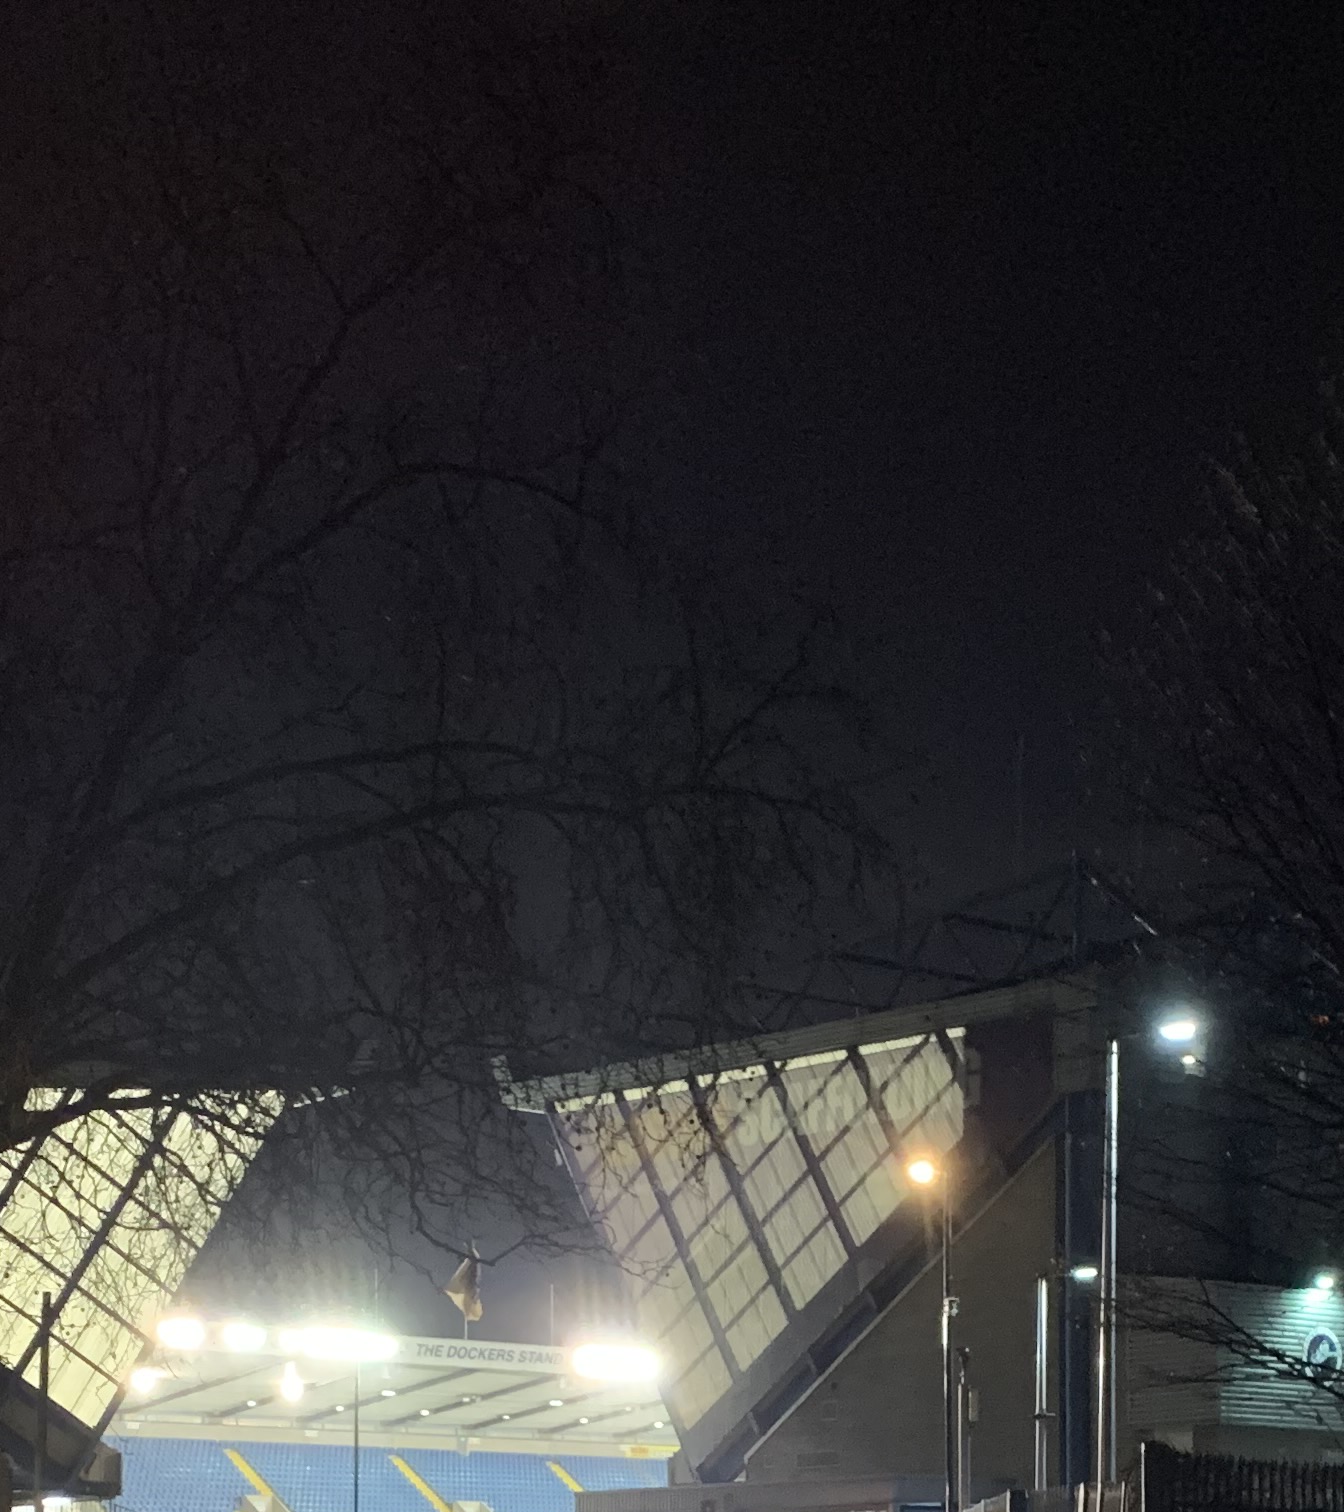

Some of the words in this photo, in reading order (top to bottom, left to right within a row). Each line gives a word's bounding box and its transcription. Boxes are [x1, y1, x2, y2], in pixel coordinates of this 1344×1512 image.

[416, 1343, 445, 1357] THE
[447, 1345, 514, 1362] DOCKERS
[518, 1350, 564, 1365] STAND
